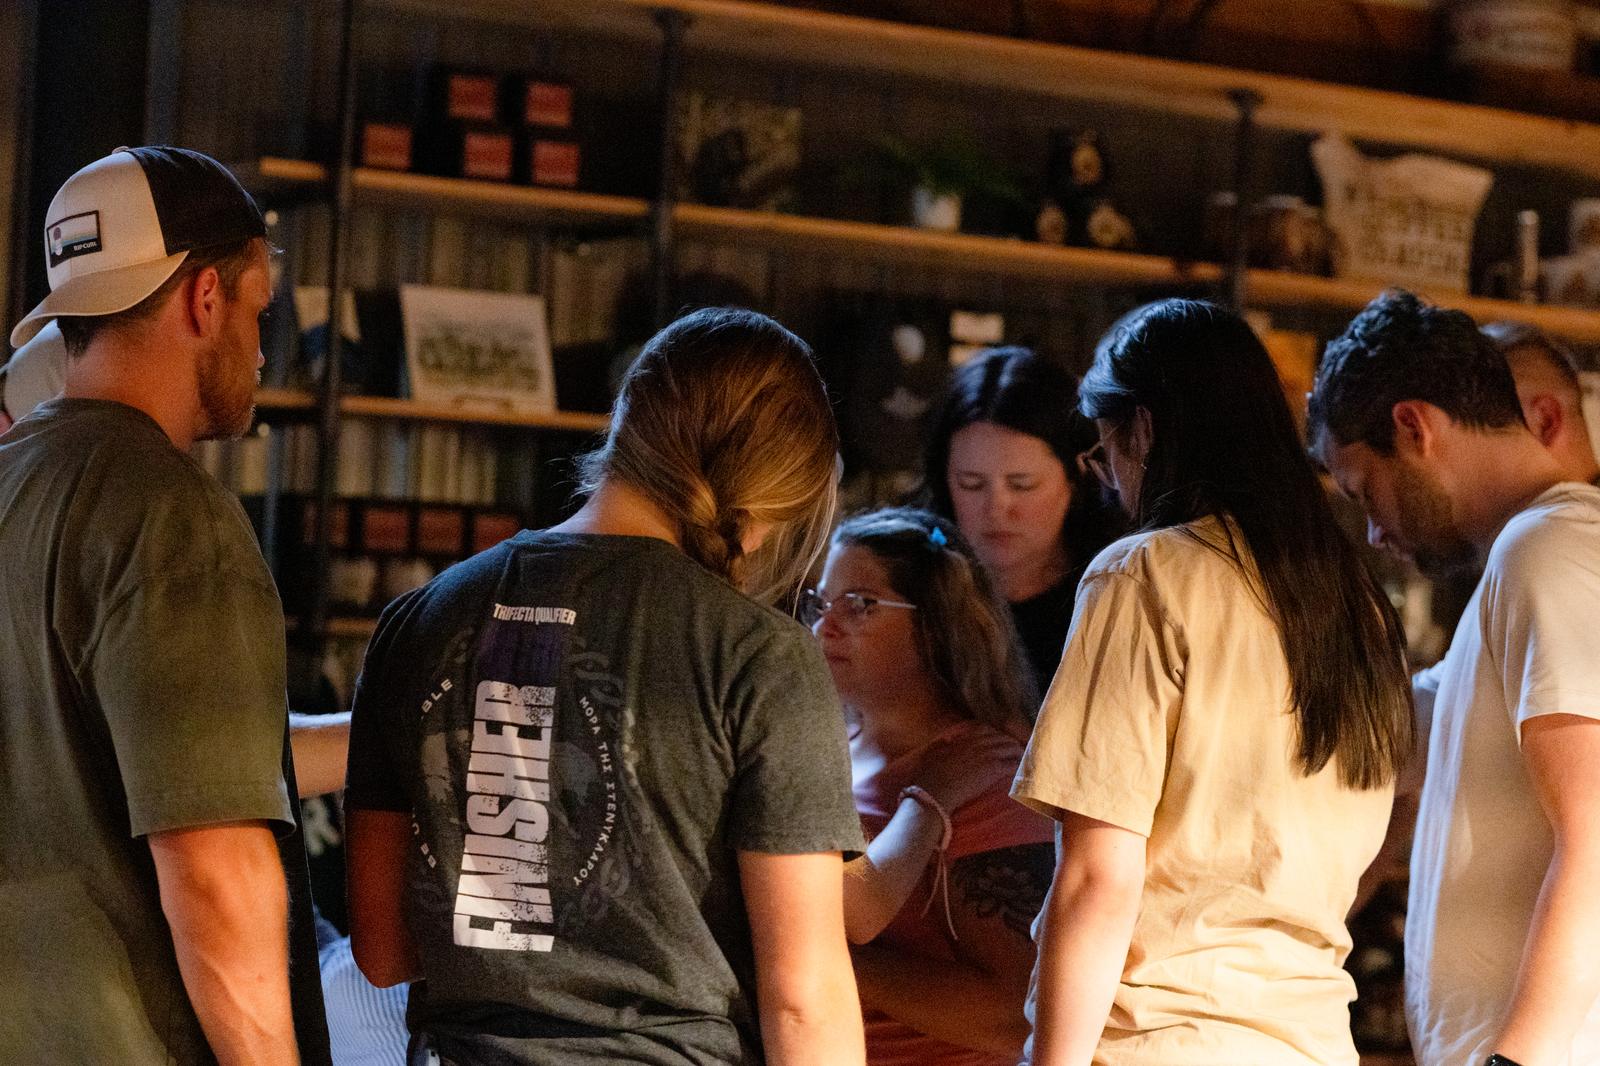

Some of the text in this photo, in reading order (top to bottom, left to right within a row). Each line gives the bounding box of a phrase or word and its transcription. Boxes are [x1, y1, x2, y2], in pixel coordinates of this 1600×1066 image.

[493, 603, 577, 625] TRIFECTA QUALIFIER
[421, 679, 453, 719] BLE
[453, 680, 556, 952] FINISHER
